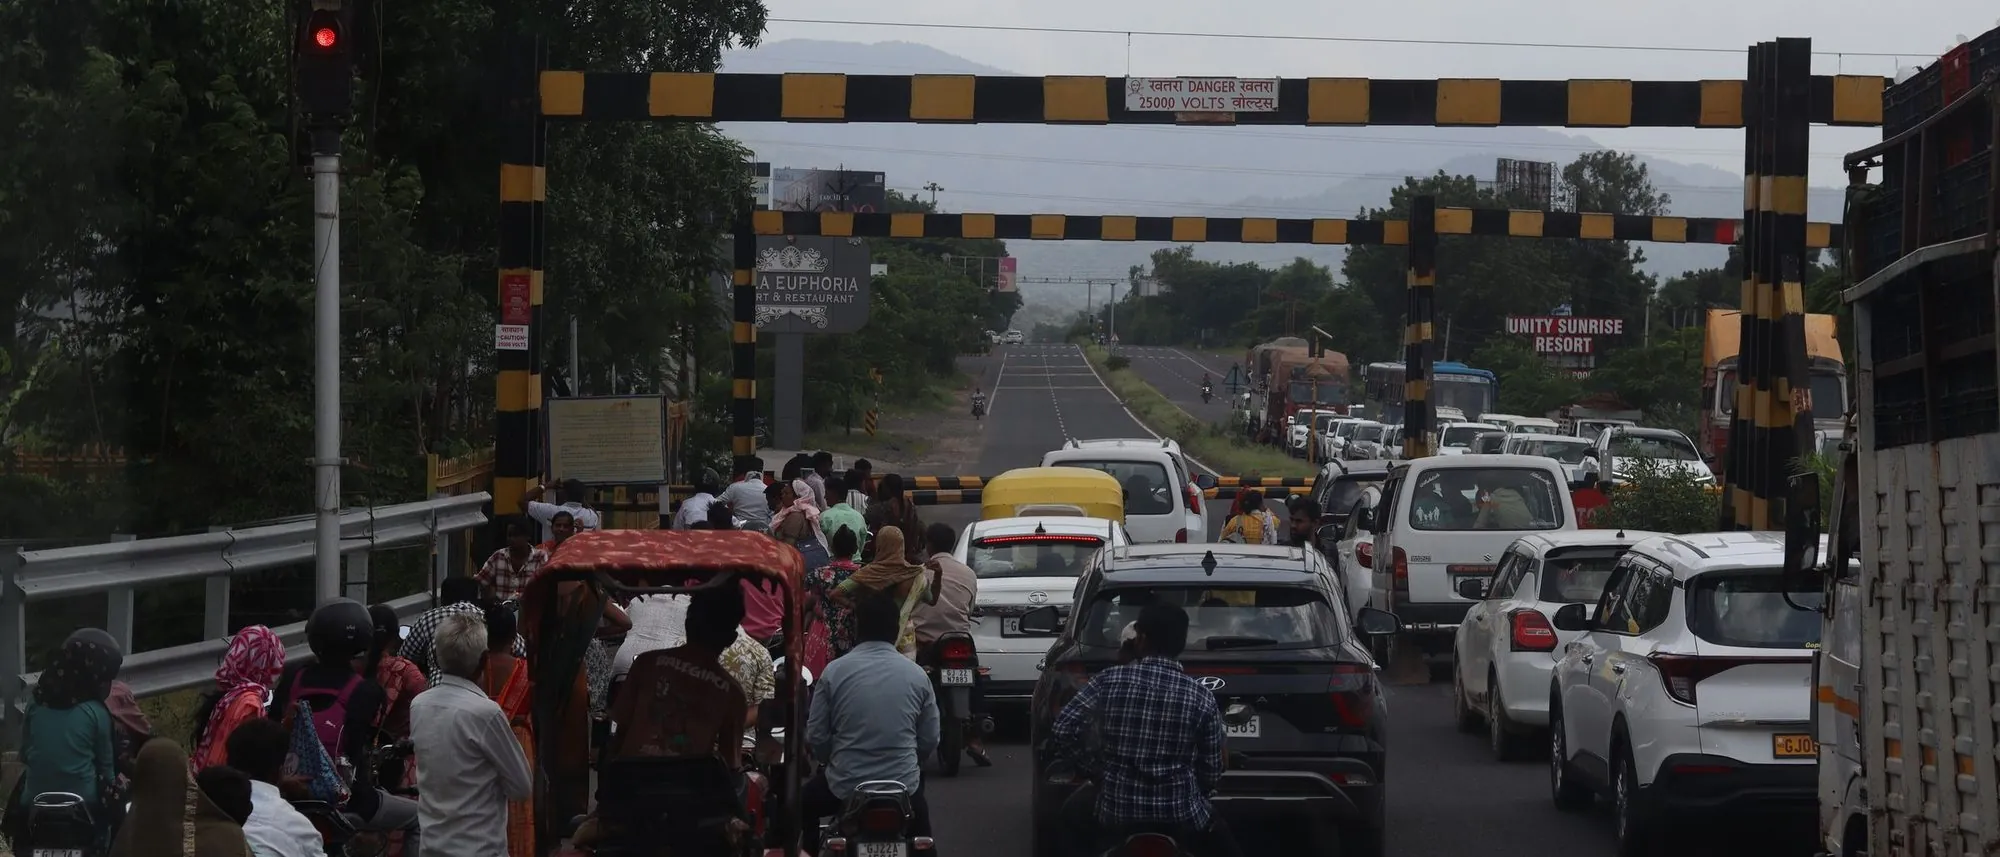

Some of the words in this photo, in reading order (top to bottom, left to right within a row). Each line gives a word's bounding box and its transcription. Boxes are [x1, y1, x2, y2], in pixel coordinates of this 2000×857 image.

[1148, 80, 1183, 92] खतरा
[1188, 81, 1235, 92] DANGER
[1239, 80, 1274, 93] खतरा
[1140, 97, 1175, 109] 25000
[1181, 97, 1225, 109] VOLTS
[776, 275, 859, 292] EUPHORIA
[773, 292, 781, 302] &
[785, 294, 854, 304] RESTAURANT
[1509, 318, 1554, 334] UNITY
[1558, 318, 1623, 334] SUNRISE
[1536, 336, 1592, 353] RESORT
[867, 844, 898, 853] GJ22A
